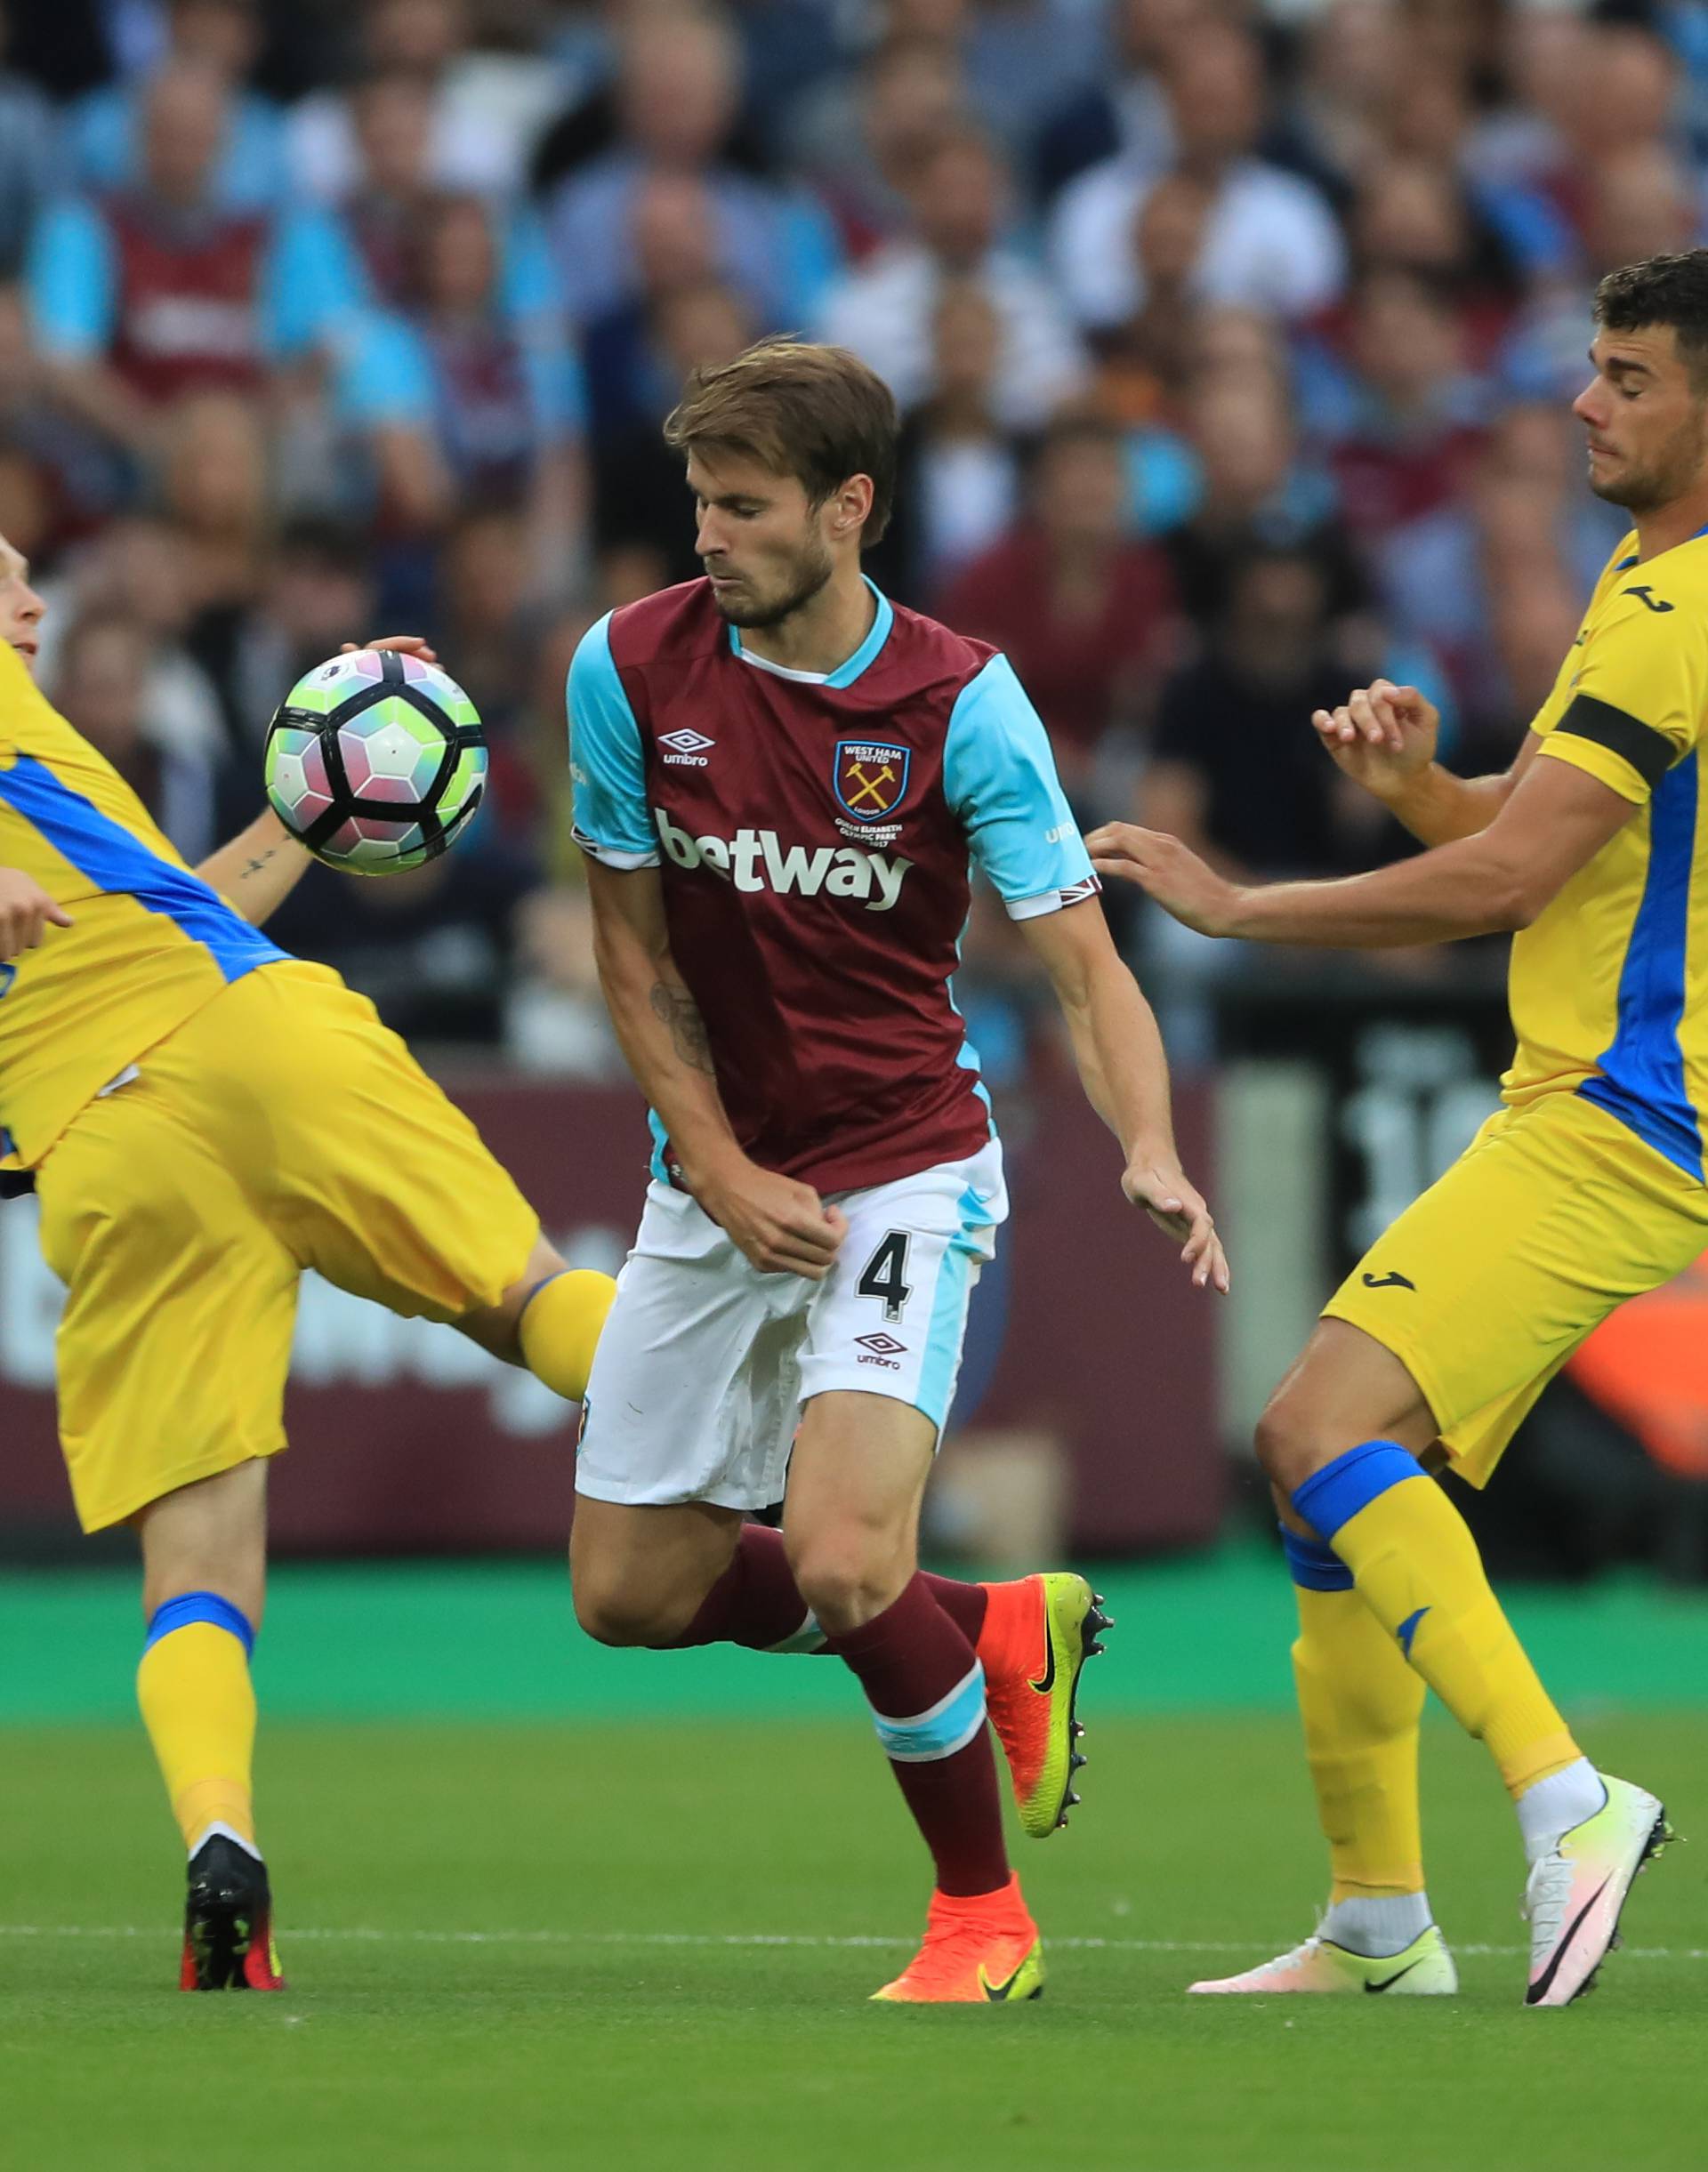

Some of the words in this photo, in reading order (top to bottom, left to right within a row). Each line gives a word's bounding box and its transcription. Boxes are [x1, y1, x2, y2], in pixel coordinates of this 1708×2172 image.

[664, 753, 708, 767] umbro
[844, 746, 874, 755] WEST
[876, 748, 902, 760] HAM
[856, 754, 890, 764] UNITED
[861, 825, 902, 833] ELIZABETH
[875, 833, 896, 841] PARK
[655, 808, 915, 911] betway
[854, 1228, 914, 1324] 4
[857, 1354, 901, 1371] umbro
